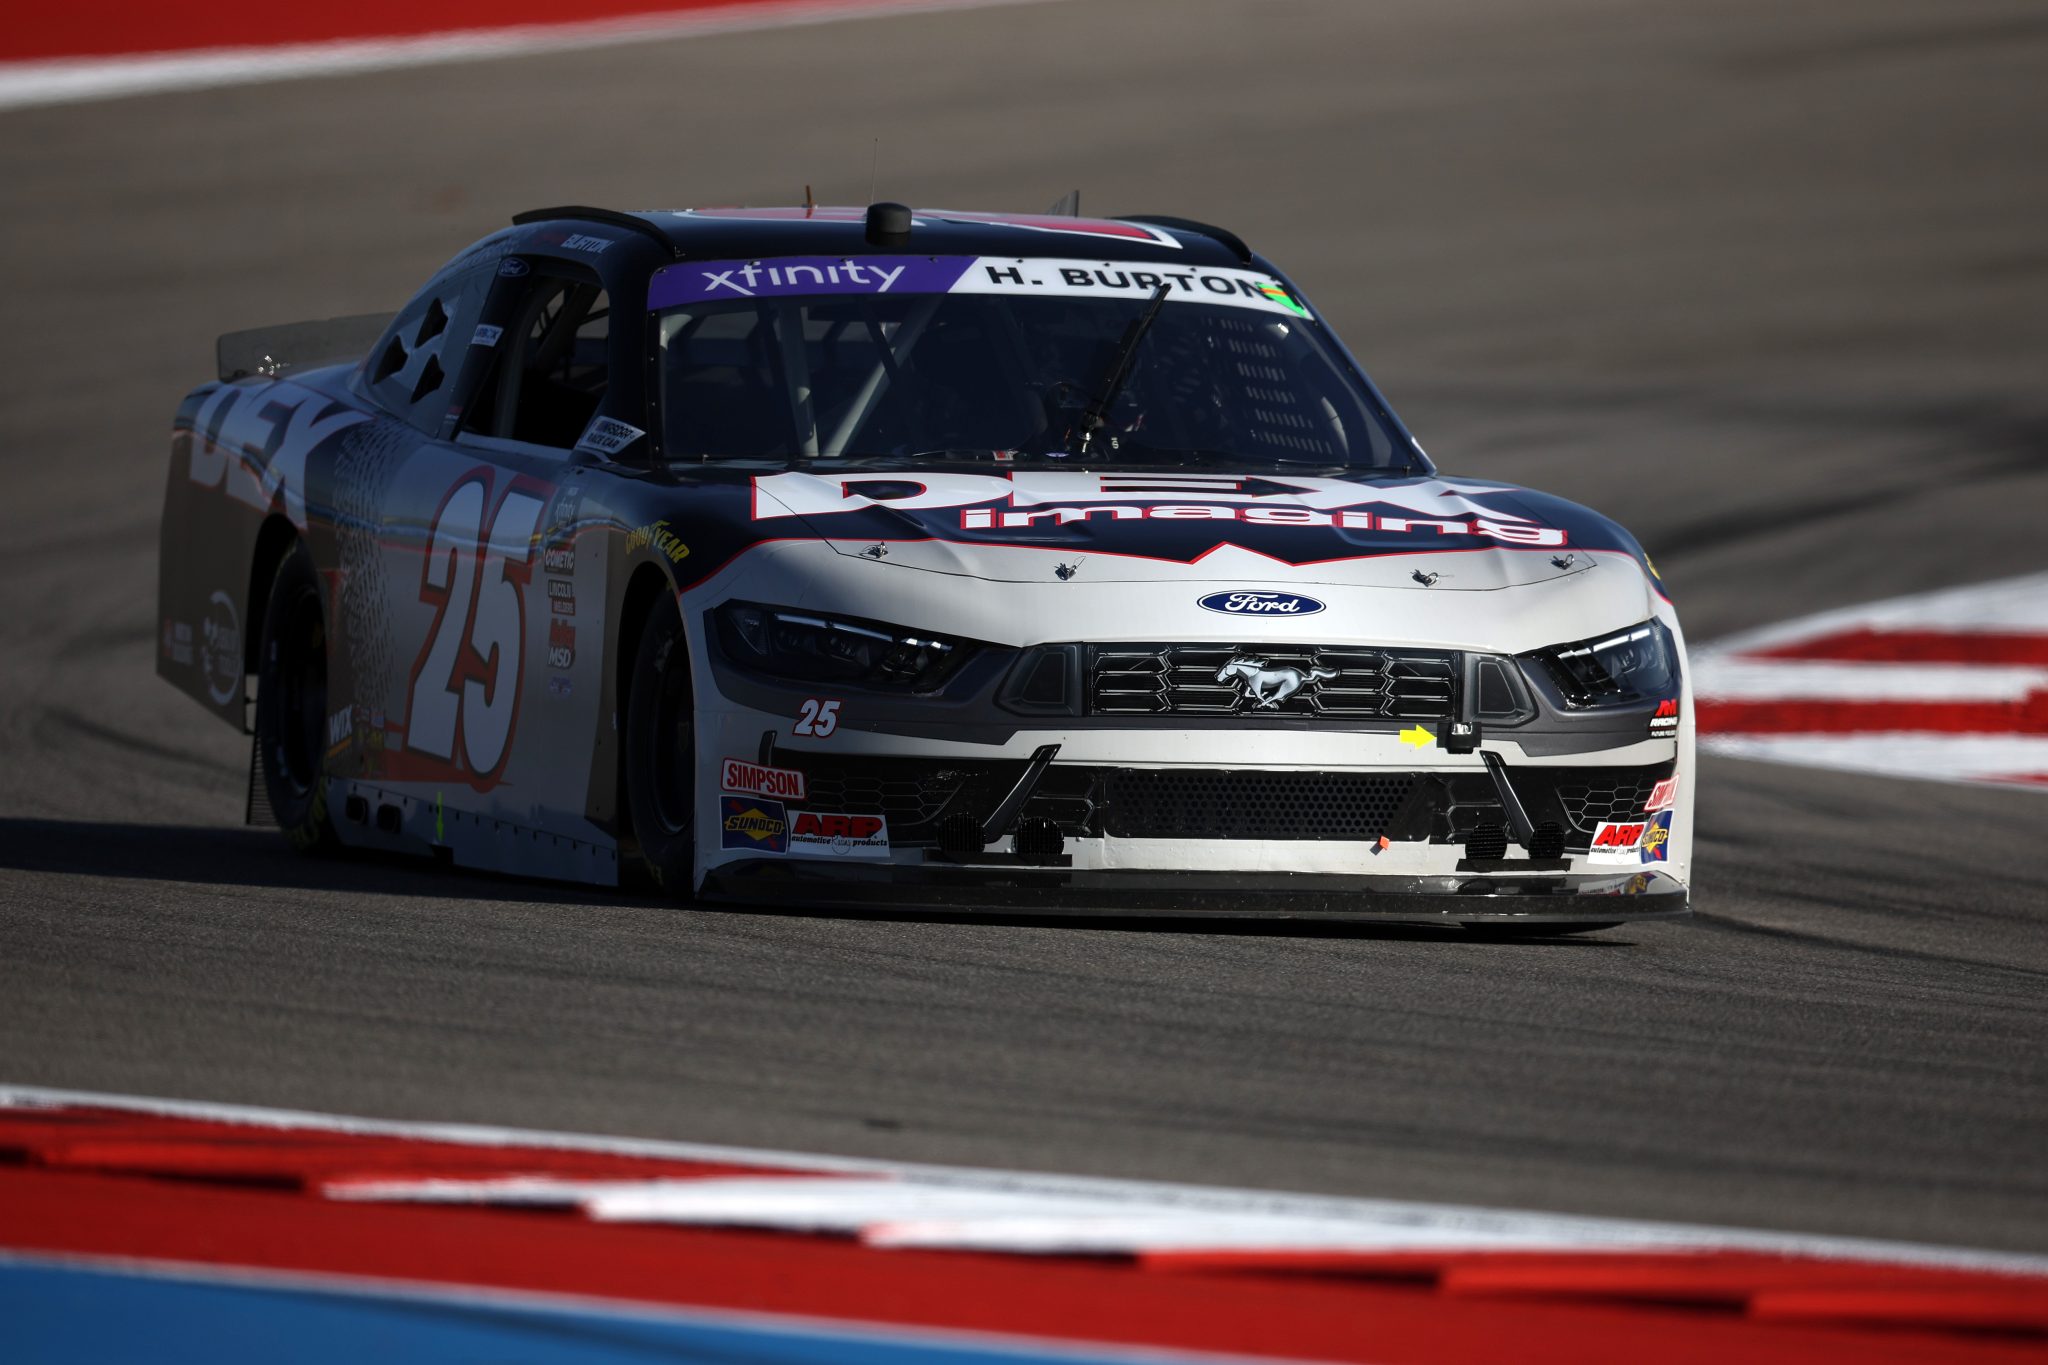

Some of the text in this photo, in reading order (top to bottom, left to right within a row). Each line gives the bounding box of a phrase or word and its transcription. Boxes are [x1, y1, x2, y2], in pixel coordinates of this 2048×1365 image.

[701, 260, 906, 296] xfinity
[986, 266, 1304, 310] H. BURTON
[751, 471, 1543, 524] DEX
[961, 504, 1567, 547] imaging
[1221, 589, 1305, 615] Ford
[405, 466, 554, 779] 25
[793, 699, 841, 737] 25
[726, 763, 800, 797] SIMPSON
[729, 816, 783, 835] SUNOCO
[791, 813, 883, 839] ARP
[1594, 824, 1645, 847] ARP
[852, 839, 888, 848] products
